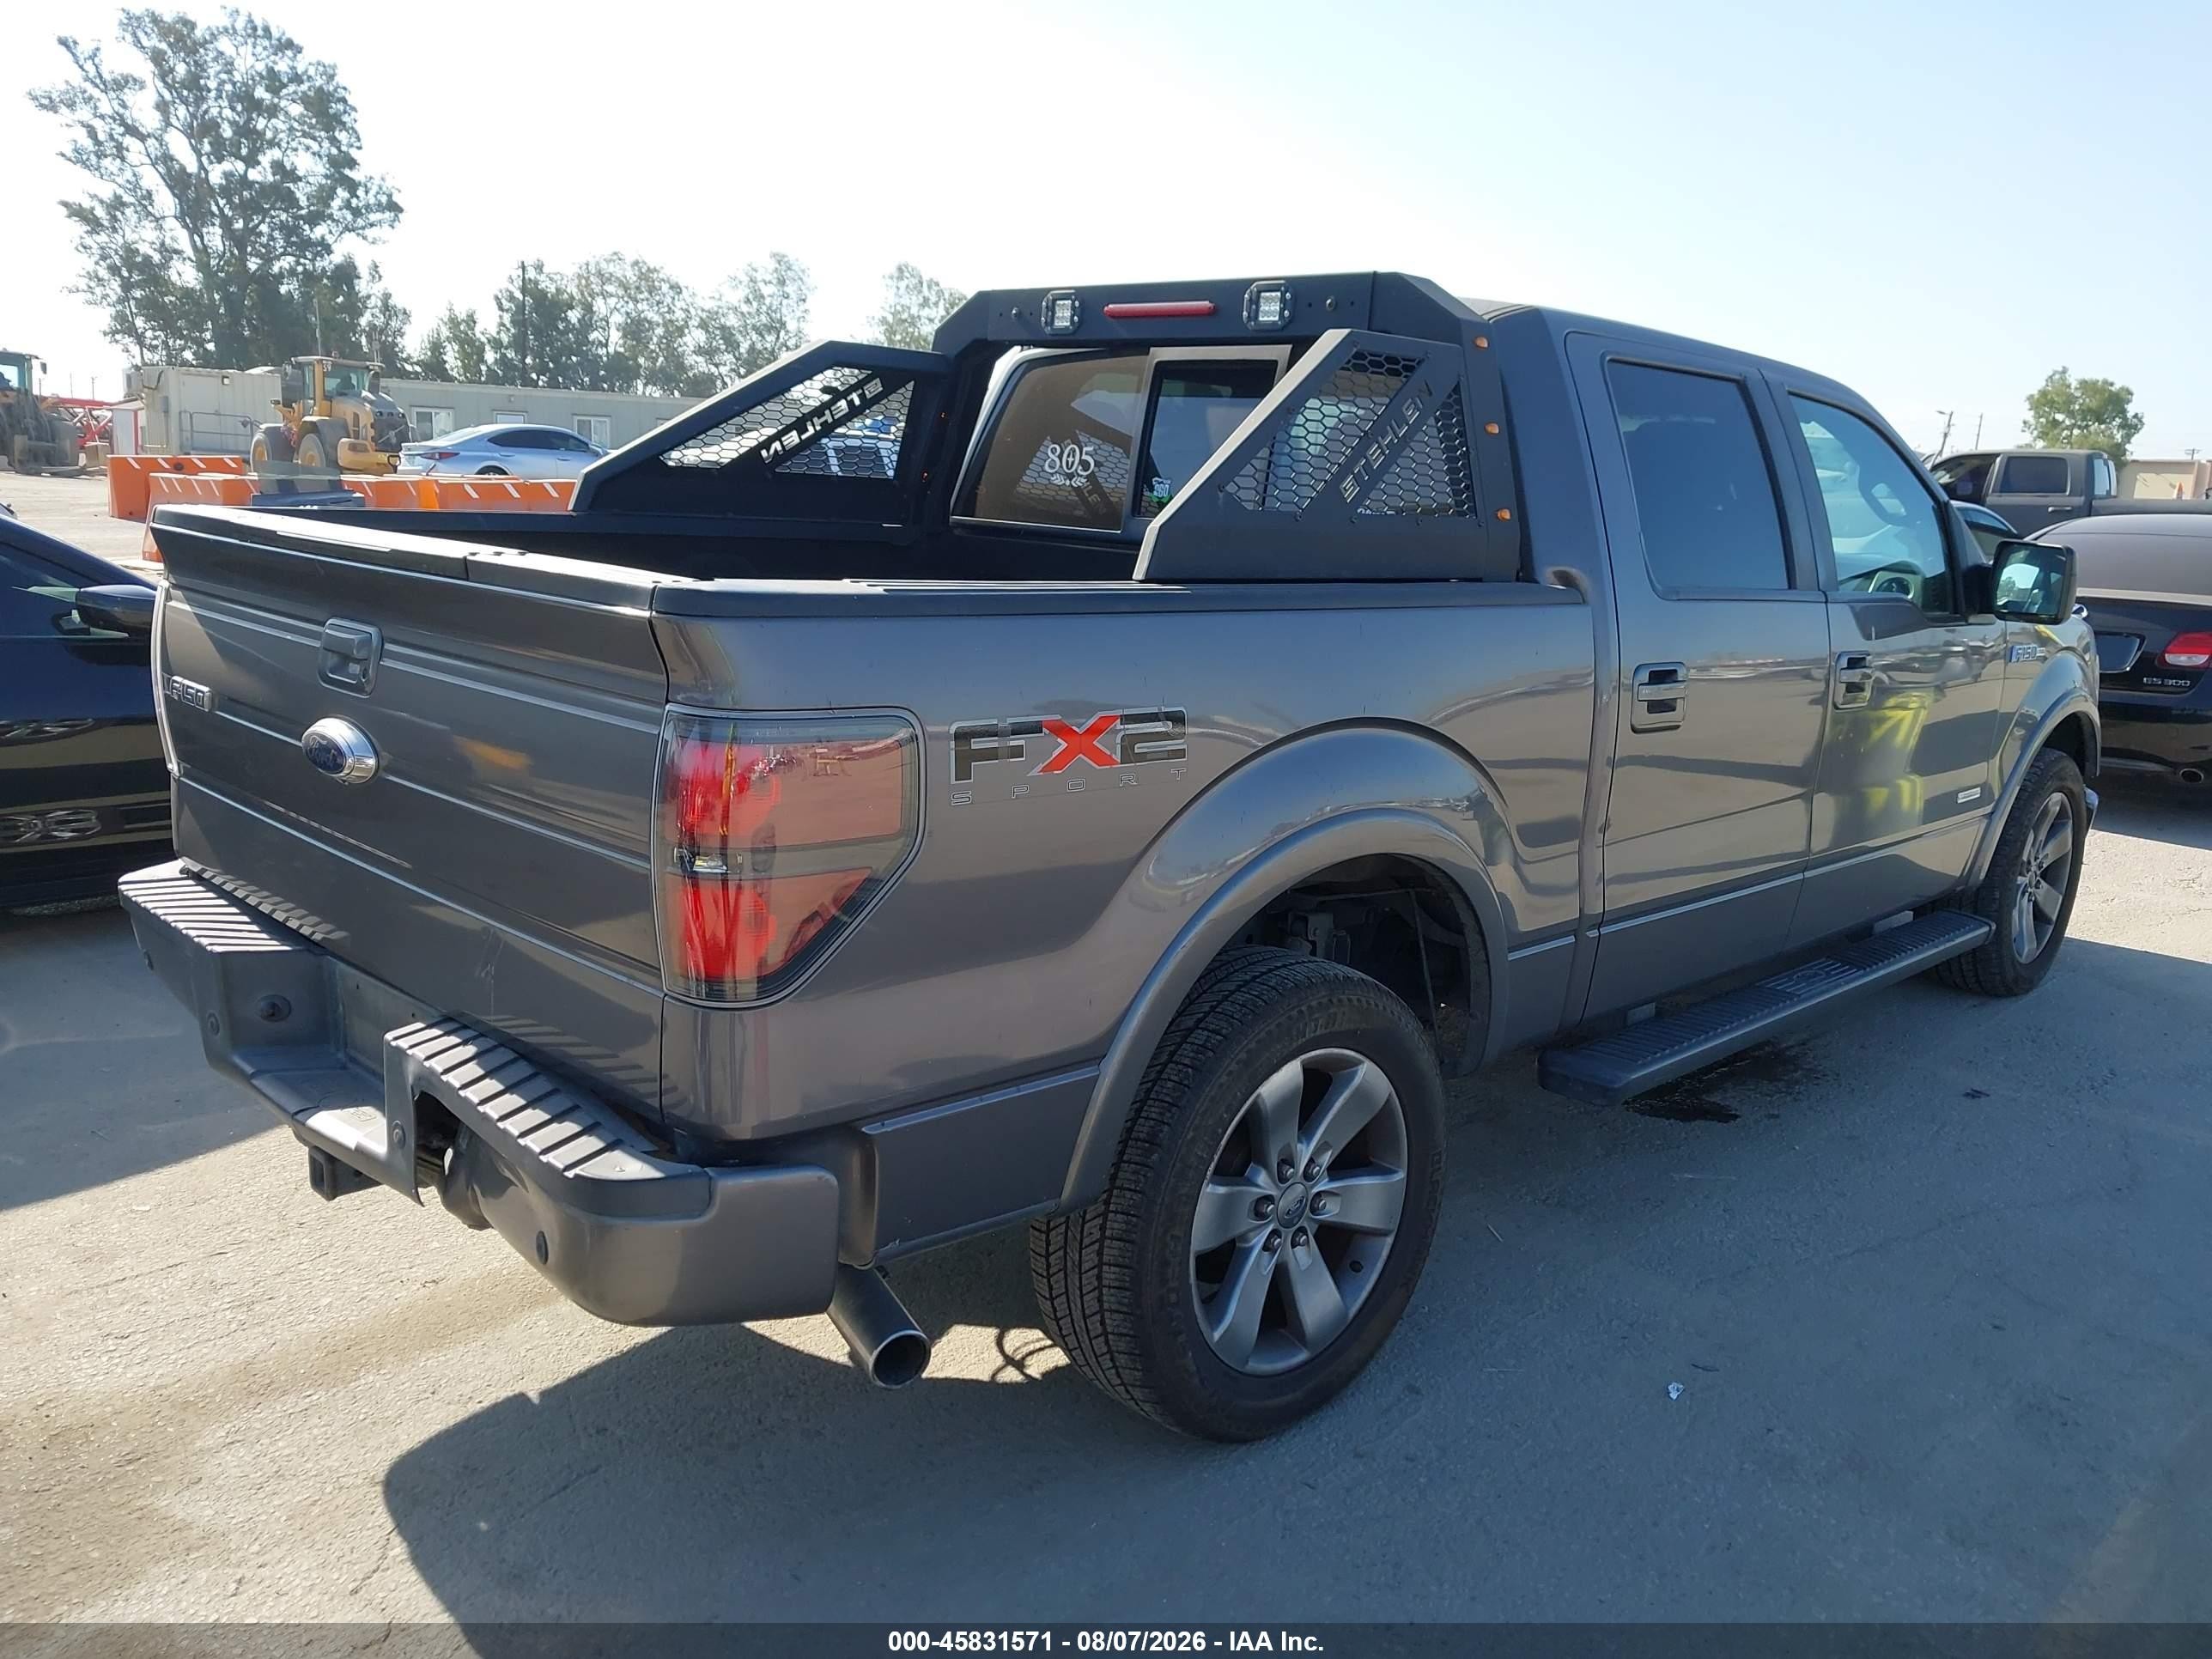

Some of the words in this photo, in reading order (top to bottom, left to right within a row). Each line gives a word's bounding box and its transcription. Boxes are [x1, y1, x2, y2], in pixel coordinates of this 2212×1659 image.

[1044, 444, 1095, 476] 805
[950, 707, 1187, 784] FX2
[951, 768, 1187, 805] SPORT
